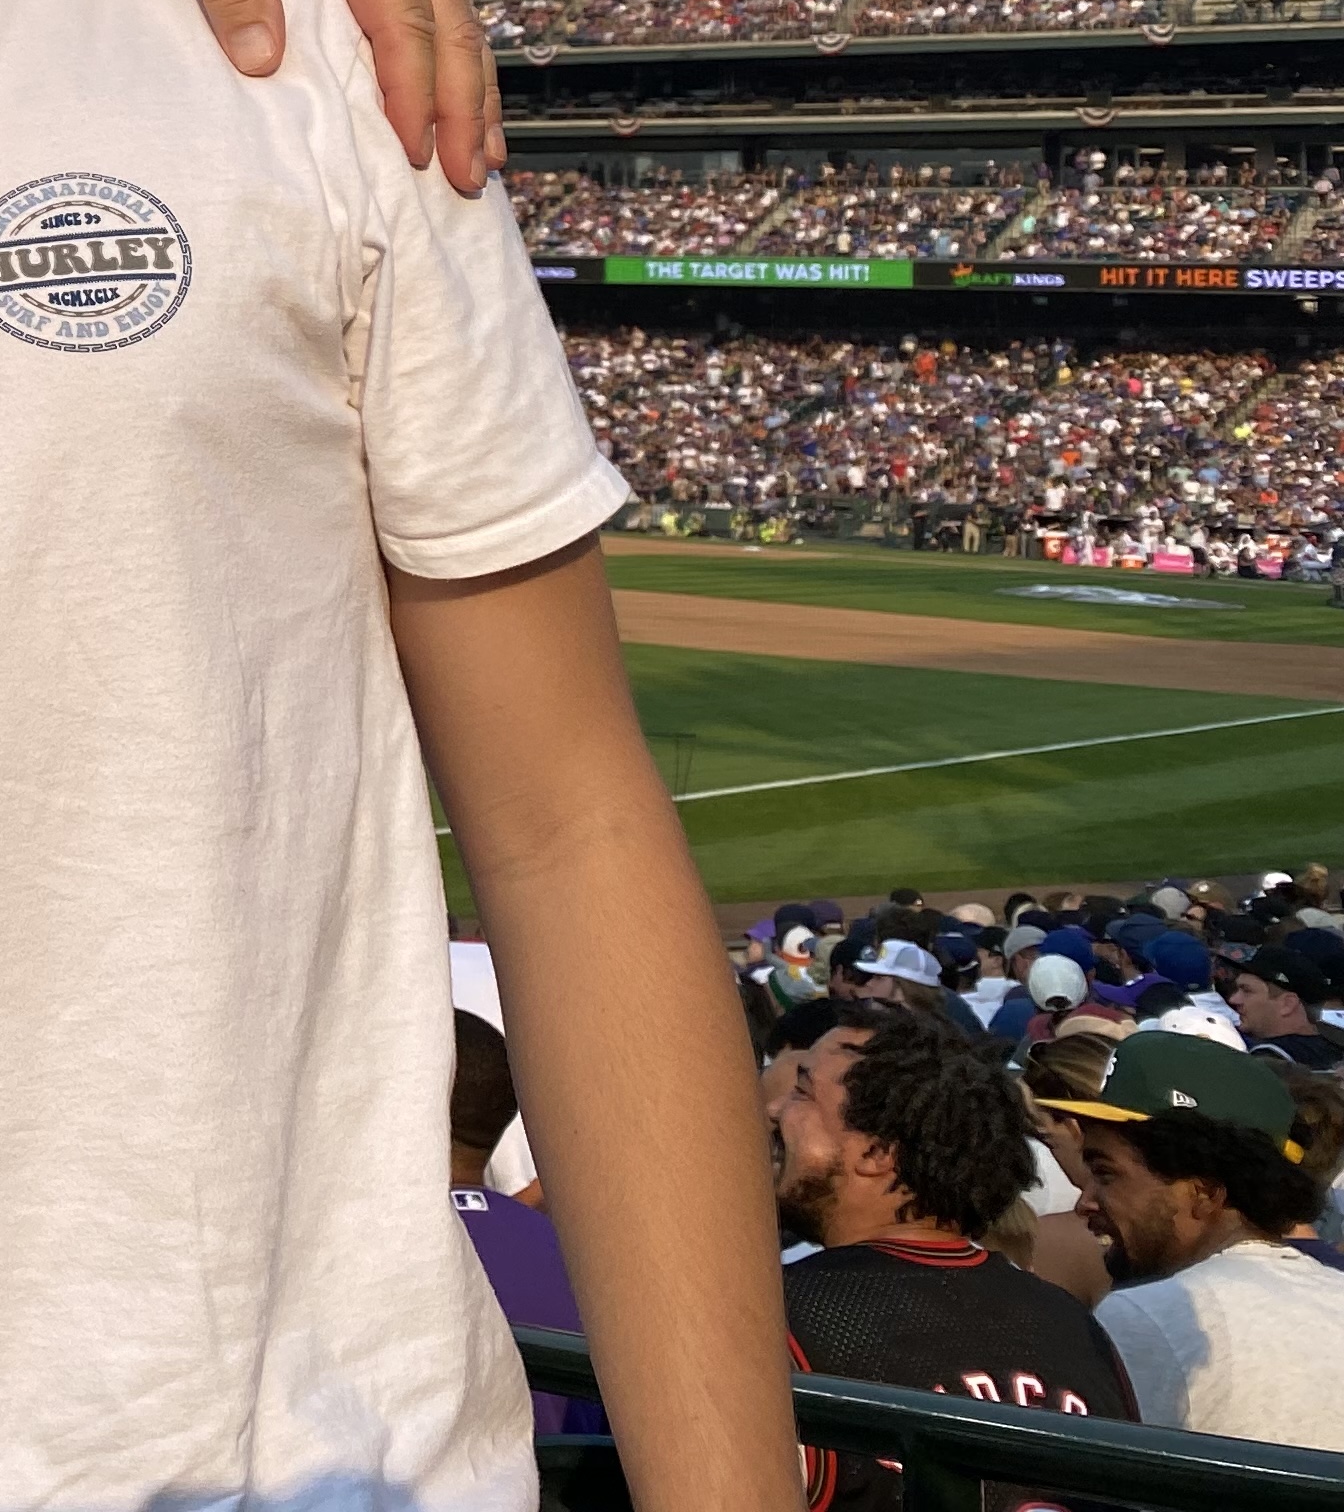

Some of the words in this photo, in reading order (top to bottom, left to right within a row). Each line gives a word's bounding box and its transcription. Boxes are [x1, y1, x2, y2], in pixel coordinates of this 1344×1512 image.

[40, 212, 83, 230] SINCE
[644, 260, 684, 280] THE
[689, 261, 768, 281] TARGET
[774, 262, 823, 282] WAS
[829, 263, 870, 283] HIT!
[1099, 267, 1139, 287] HIT
[1146, 268, 1170, 287] IT
[1175, 268, 1239, 288] HERE
[47, 287, 121, 308] MCMXCIX
[56, 320, 110, 338] AND
[116, 281, 172, 332] ENJOY
